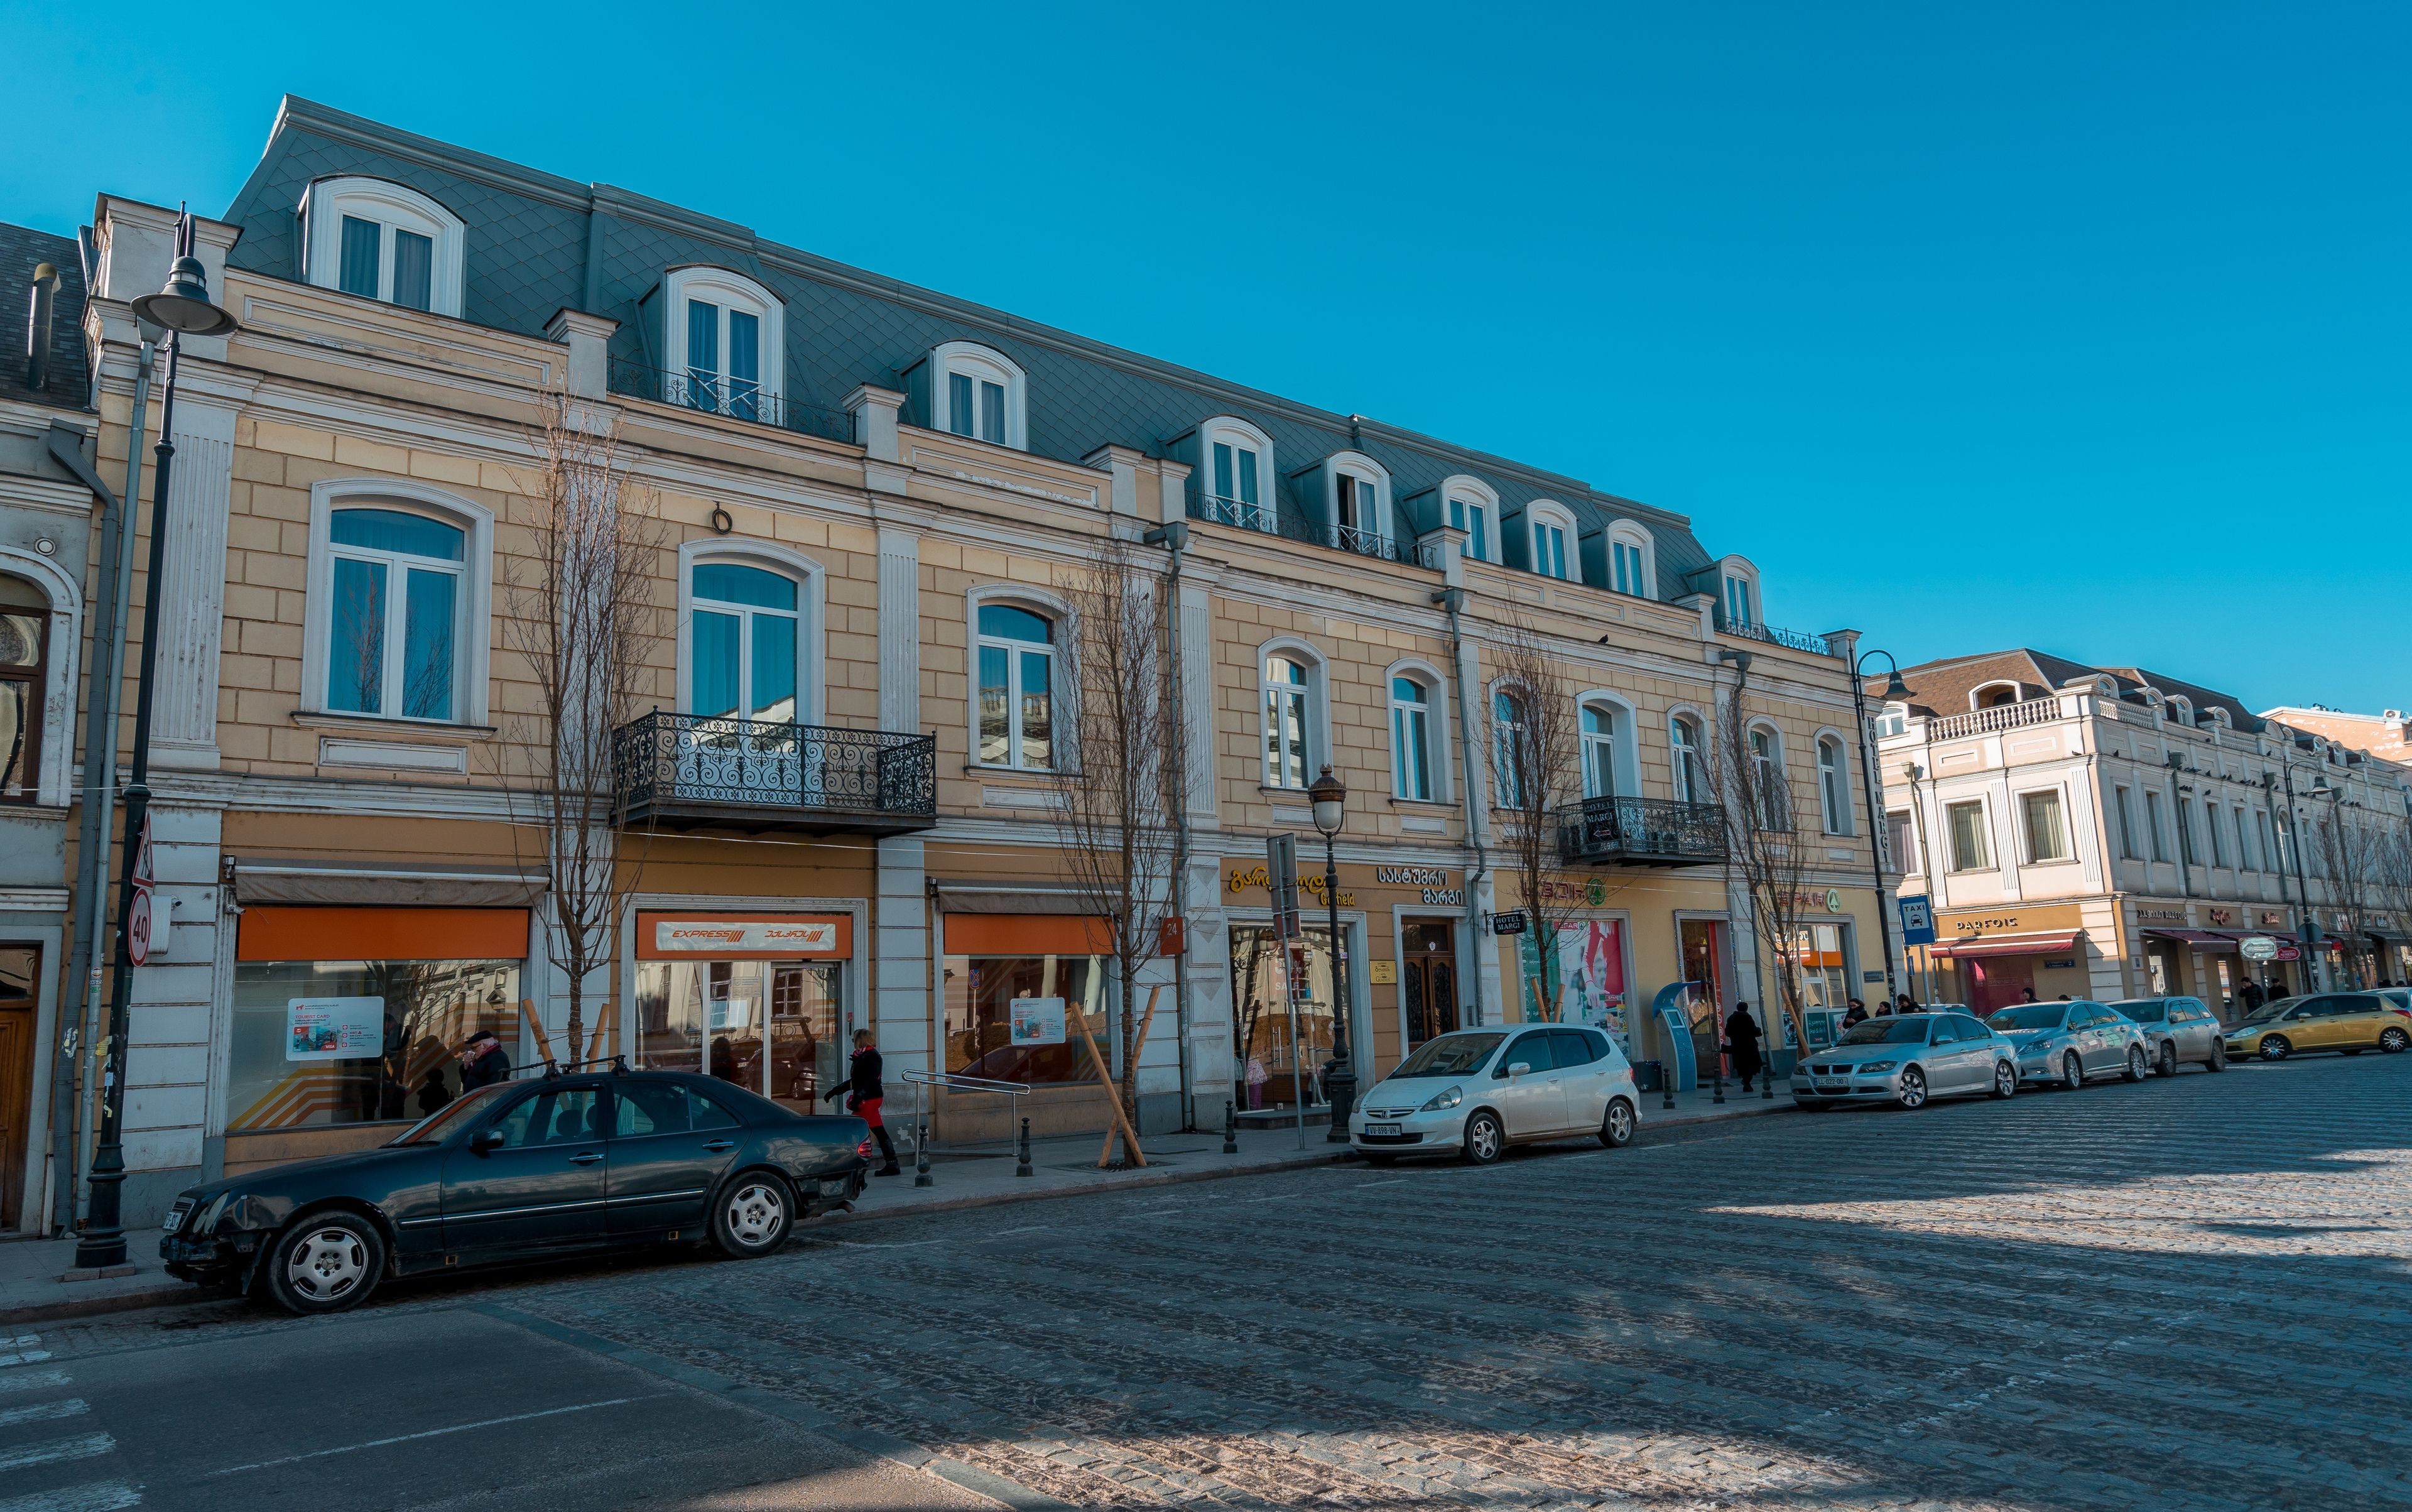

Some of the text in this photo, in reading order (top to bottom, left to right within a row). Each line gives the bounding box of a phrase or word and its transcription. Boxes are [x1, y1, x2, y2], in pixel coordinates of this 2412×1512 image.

[1377, 867, 1448, 886] სასტუმრო
[1423, 888, 1463, 905] მარგი
[1496, 916, 1521, 924] HOTEL
[1497, 922, 1520, 930] MARGI
[1956, 918, 2018, 930] PARFOIS
[133, 915, 148, 943] 40
[672, 930, 731, 938] EXPRESS
[1166, 923, 1177, 937] 24
[1369, 1126, 1396, 1134] VV-898-VN
